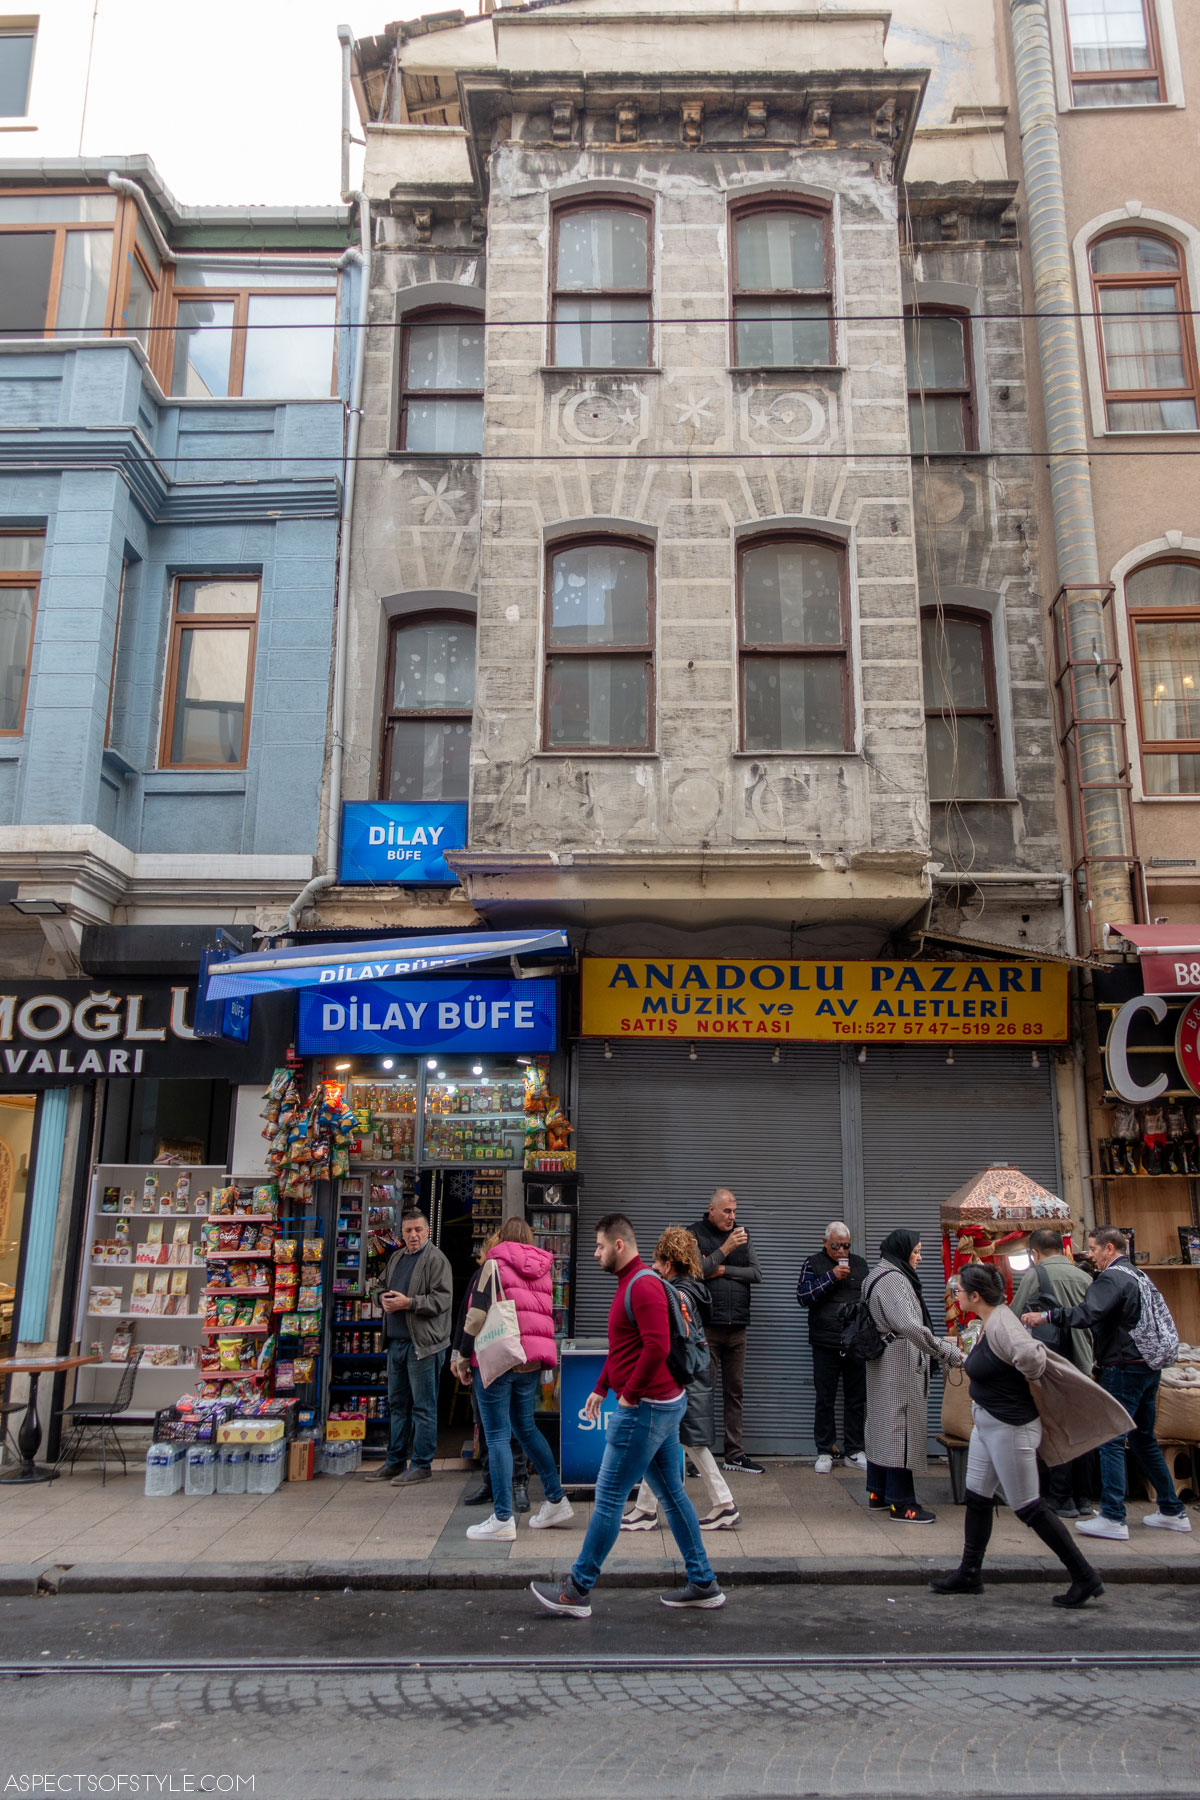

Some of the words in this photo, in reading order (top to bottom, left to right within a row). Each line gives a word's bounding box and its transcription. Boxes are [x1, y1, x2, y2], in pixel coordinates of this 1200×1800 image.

[368, 821, 444, 845] DİLAY
[387, 848, 422, 860] BÜFE
[319, 964, 390, 983] DİLAY
[608, 963, 844, 991] ANADOLU
[870, 966, 1043, 993] PAZARI
[322, 995, 428, 1031] DİLAY
[438, 994, 535, 1030] BÜFE
[641, 993, 747, 1016] MÜZİK
[758, 1002, 794, 1016] ve
[815, 998, 859, 1017] AV
[872, 997, 1008, 1018] ALETLERİ
[620, 1018, 678, 1034] SATIŞ
[697, 1020, 790, 1033] NOKTASI
[903, 1022, 923, 1035] 57
[996, 1023, 1017, 1035] 26
[1023, 1023, 1043, 1035] 83
[0, 1048, 144, 1073] VALARI
